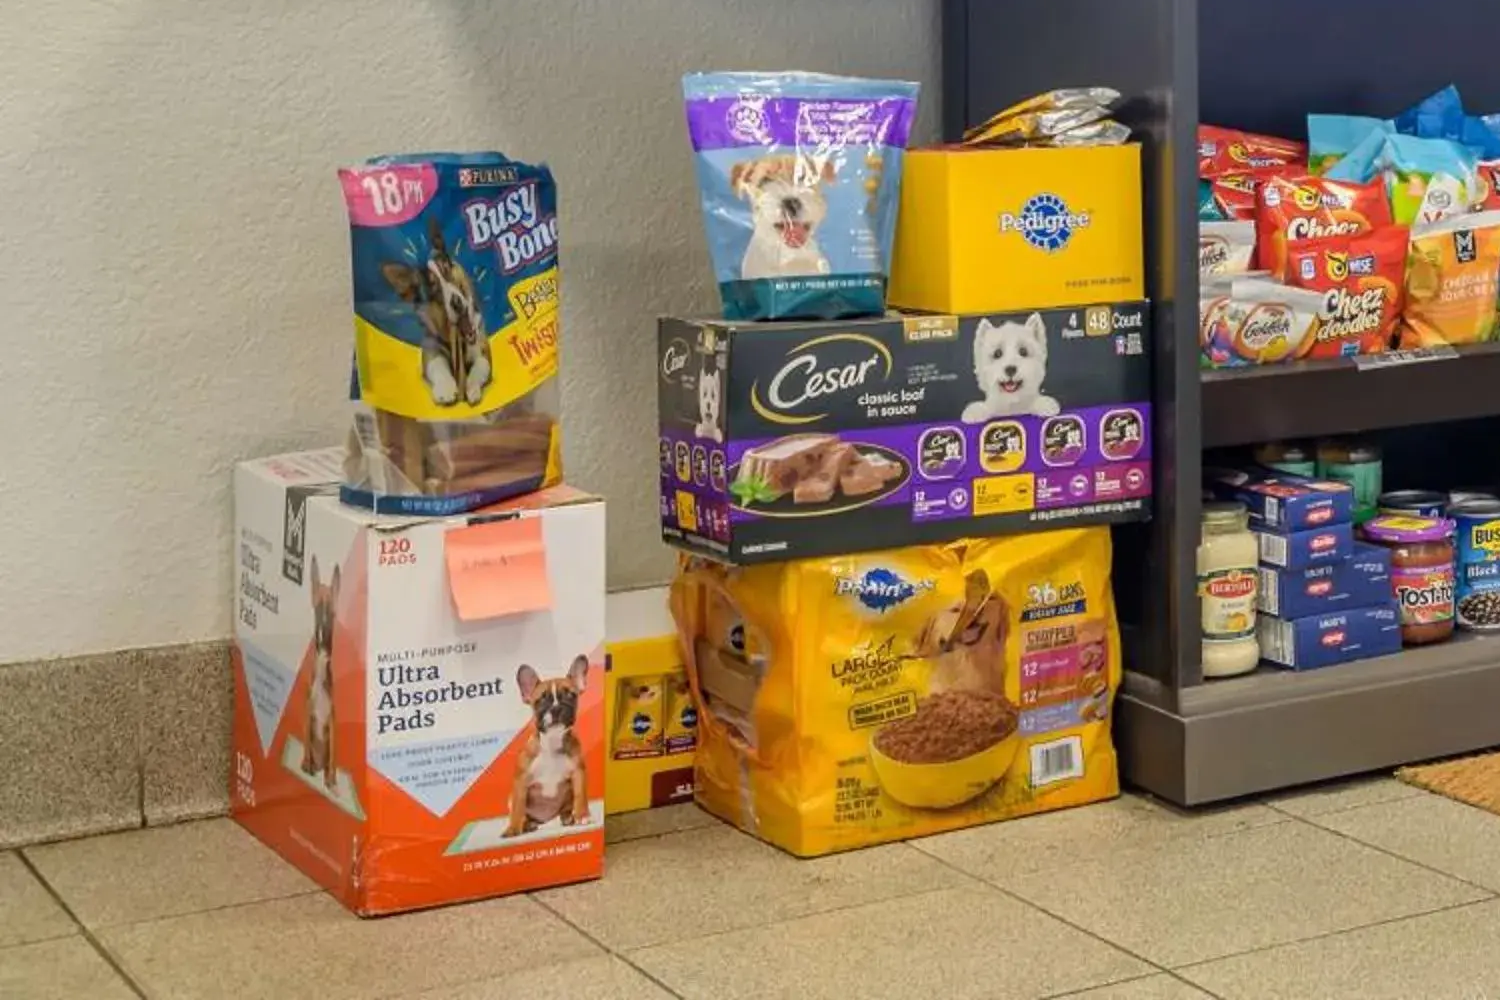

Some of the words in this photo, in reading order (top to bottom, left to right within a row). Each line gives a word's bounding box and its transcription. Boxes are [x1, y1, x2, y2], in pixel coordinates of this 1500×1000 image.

[473, 168, 516, 184] PURINA
[362, 172, 403, 216] 18
[403, 180, 424, 205] PK
[465, 183, 537, 245] Busy
[1000, 210, 1090, 238] Pedigree
[1349, 256, 1375, 274] WISE
[1326, 288, 1385, 317] Cheez
[1069, 312, 1078, 328] 4
[1088, 311, 1110, 330] 48
[1112, 311, 1143, 329] Count
[1317, 311, 1381, 341] doodles
[768, 353, 879, 410] Cesar
[857, 391, 898, 406] classic
[901, 387, 925, 402] loaf
[866, 406, 879, 418] in
[881, 404, 917, 417] sauce
[379, 537, 412, 555] 120
[378, 552, 418, 566] PADS
[1468, 564, 1496, 577] Black
[1028, 583, 1057, 605] 36
[377, 642, 478, 663] MULTI-PURPOSE
[377, 663, 441, 687] Ultra
[1023, 661, 1039, 677] 12
[376, 676, 504, 711] Absorbent
[1023, 688, 1038, 705] 12
[376, 709, 436, 734] Pads
[1021, 716, 1036, 731] 12
[236, 751, 254, 783] 120
